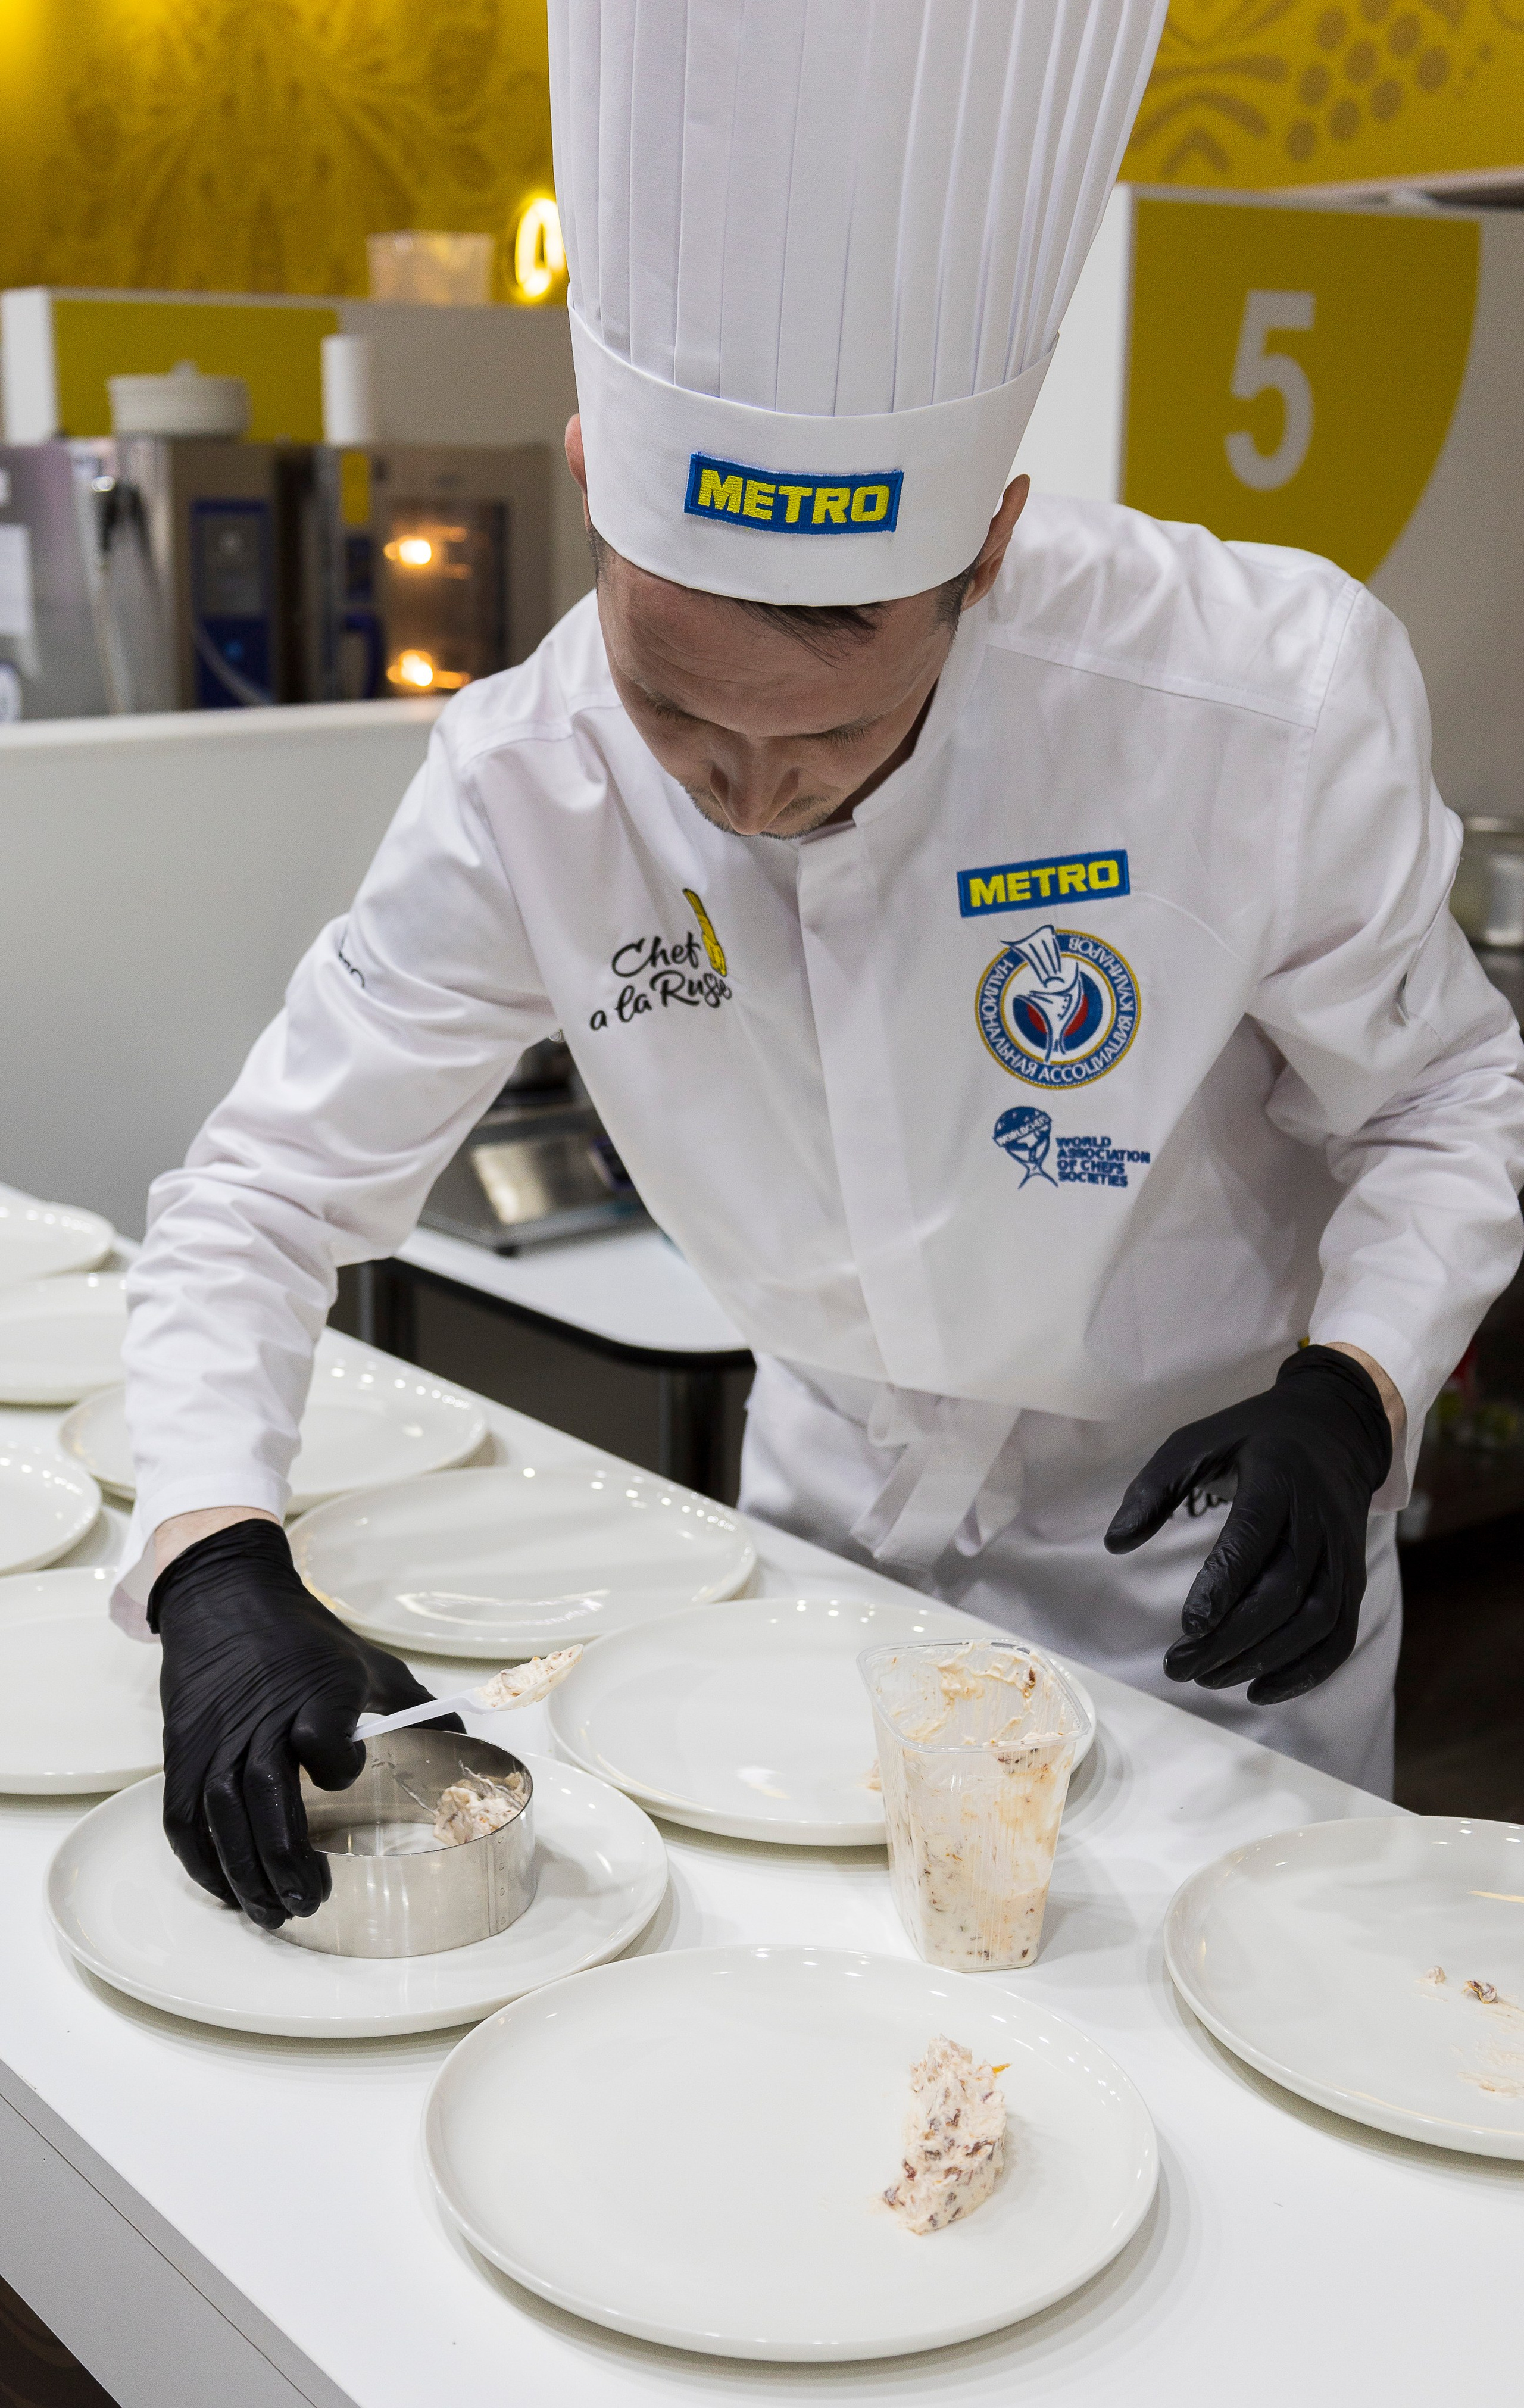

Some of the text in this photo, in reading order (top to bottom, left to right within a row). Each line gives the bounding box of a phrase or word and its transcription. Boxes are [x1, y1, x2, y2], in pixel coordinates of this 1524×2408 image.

[1224, 288, 1316, 492] 5
[698, 468, 890, 524] METRO
[969, 859, 1120, 907] METRO
[611, 931, 701, 978] Chef
[589, 1010, 608, 1031] a
[614, 985, 653, 1023] la
[981, 936, 1135, 1083] НАЦИОНАЛЬНАЯ АССОЦИАЦИЯ КУЛИНАРОВ
[1055, 1136, 1111, 1148] WORLD
[1057, 1148, 1151, 1164] ASSOCIATION
[1057, 1160, 1125, 1175] OF CHEFS
[1058, 1171, 1128, 1188] SOCIETIES
